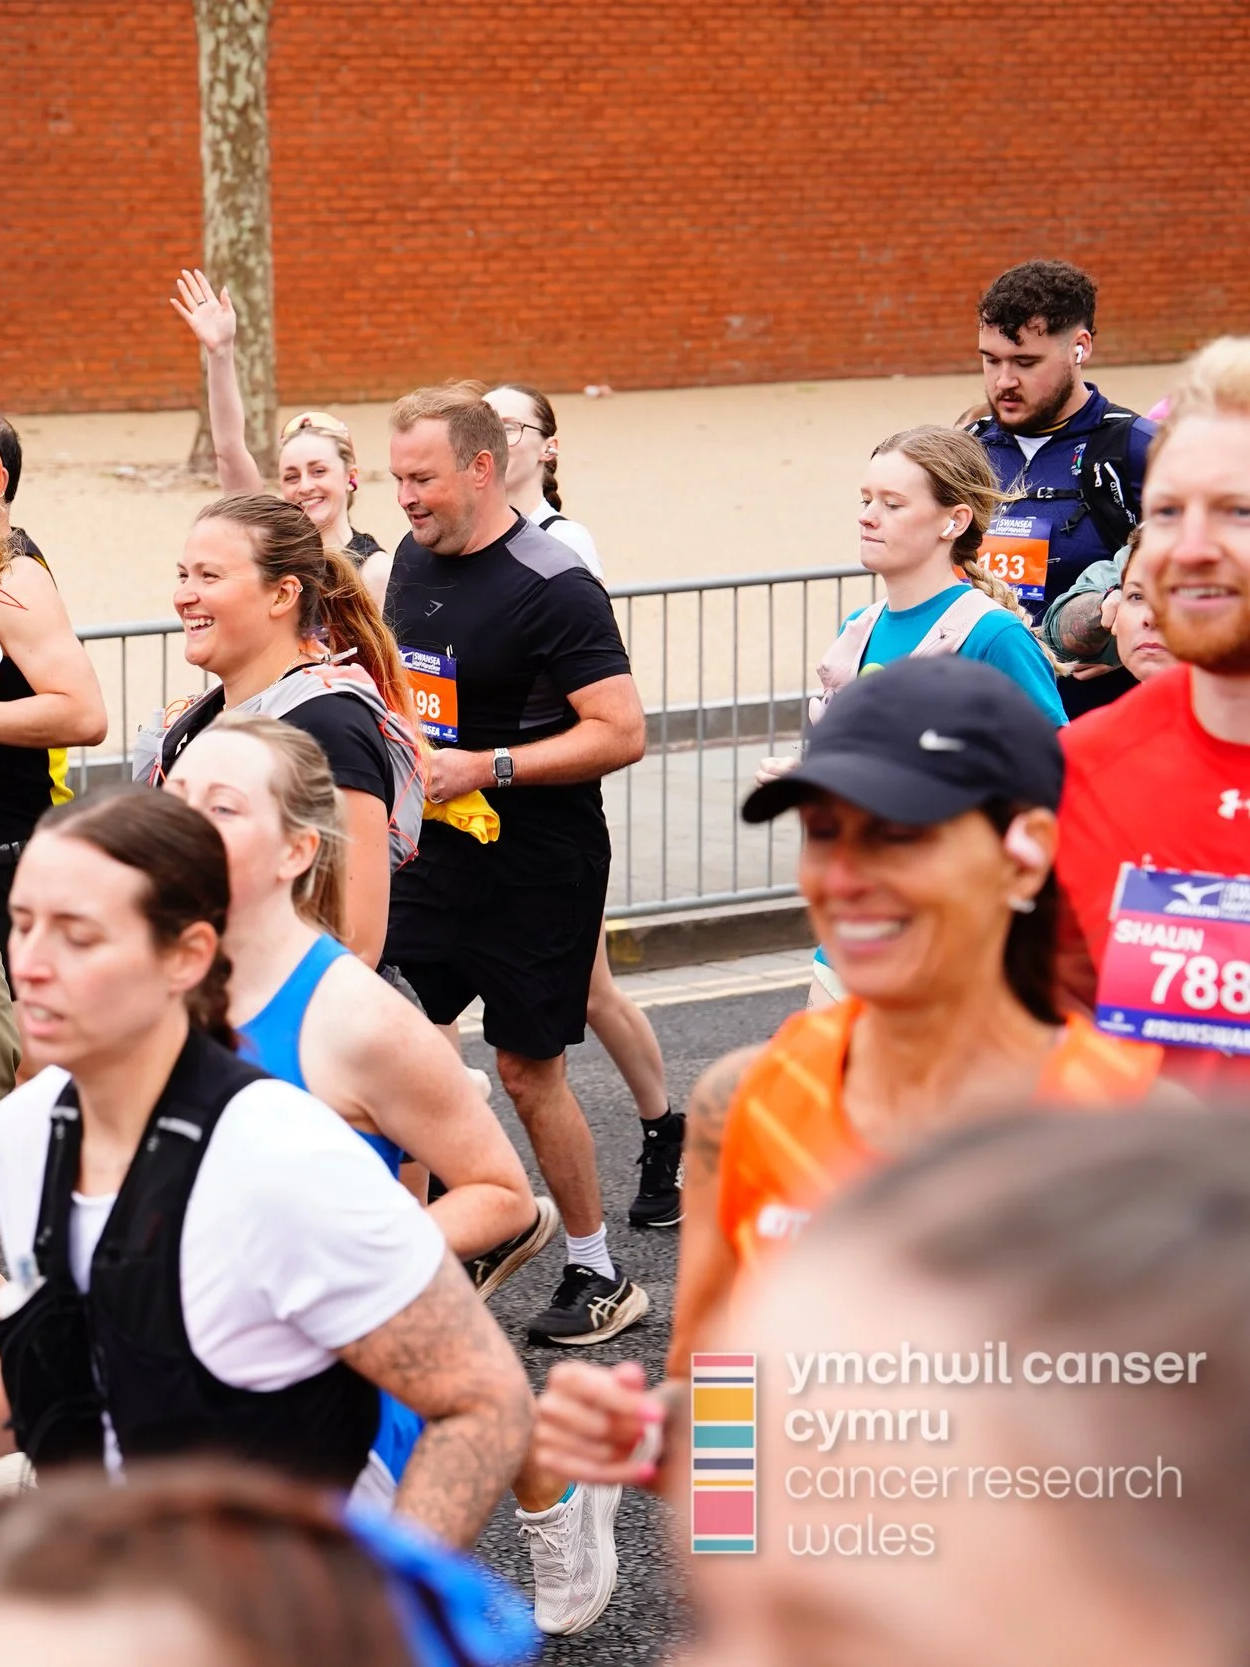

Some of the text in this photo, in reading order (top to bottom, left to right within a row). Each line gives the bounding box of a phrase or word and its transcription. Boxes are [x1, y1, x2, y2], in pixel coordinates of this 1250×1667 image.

[1000, 518, 1032, 528] SWANSEA
[414, 652, 441, 666] SWANSEA
[1113, 918, 1205, 953] SHAUN
[1151, 951, 1250, 1014] 788
